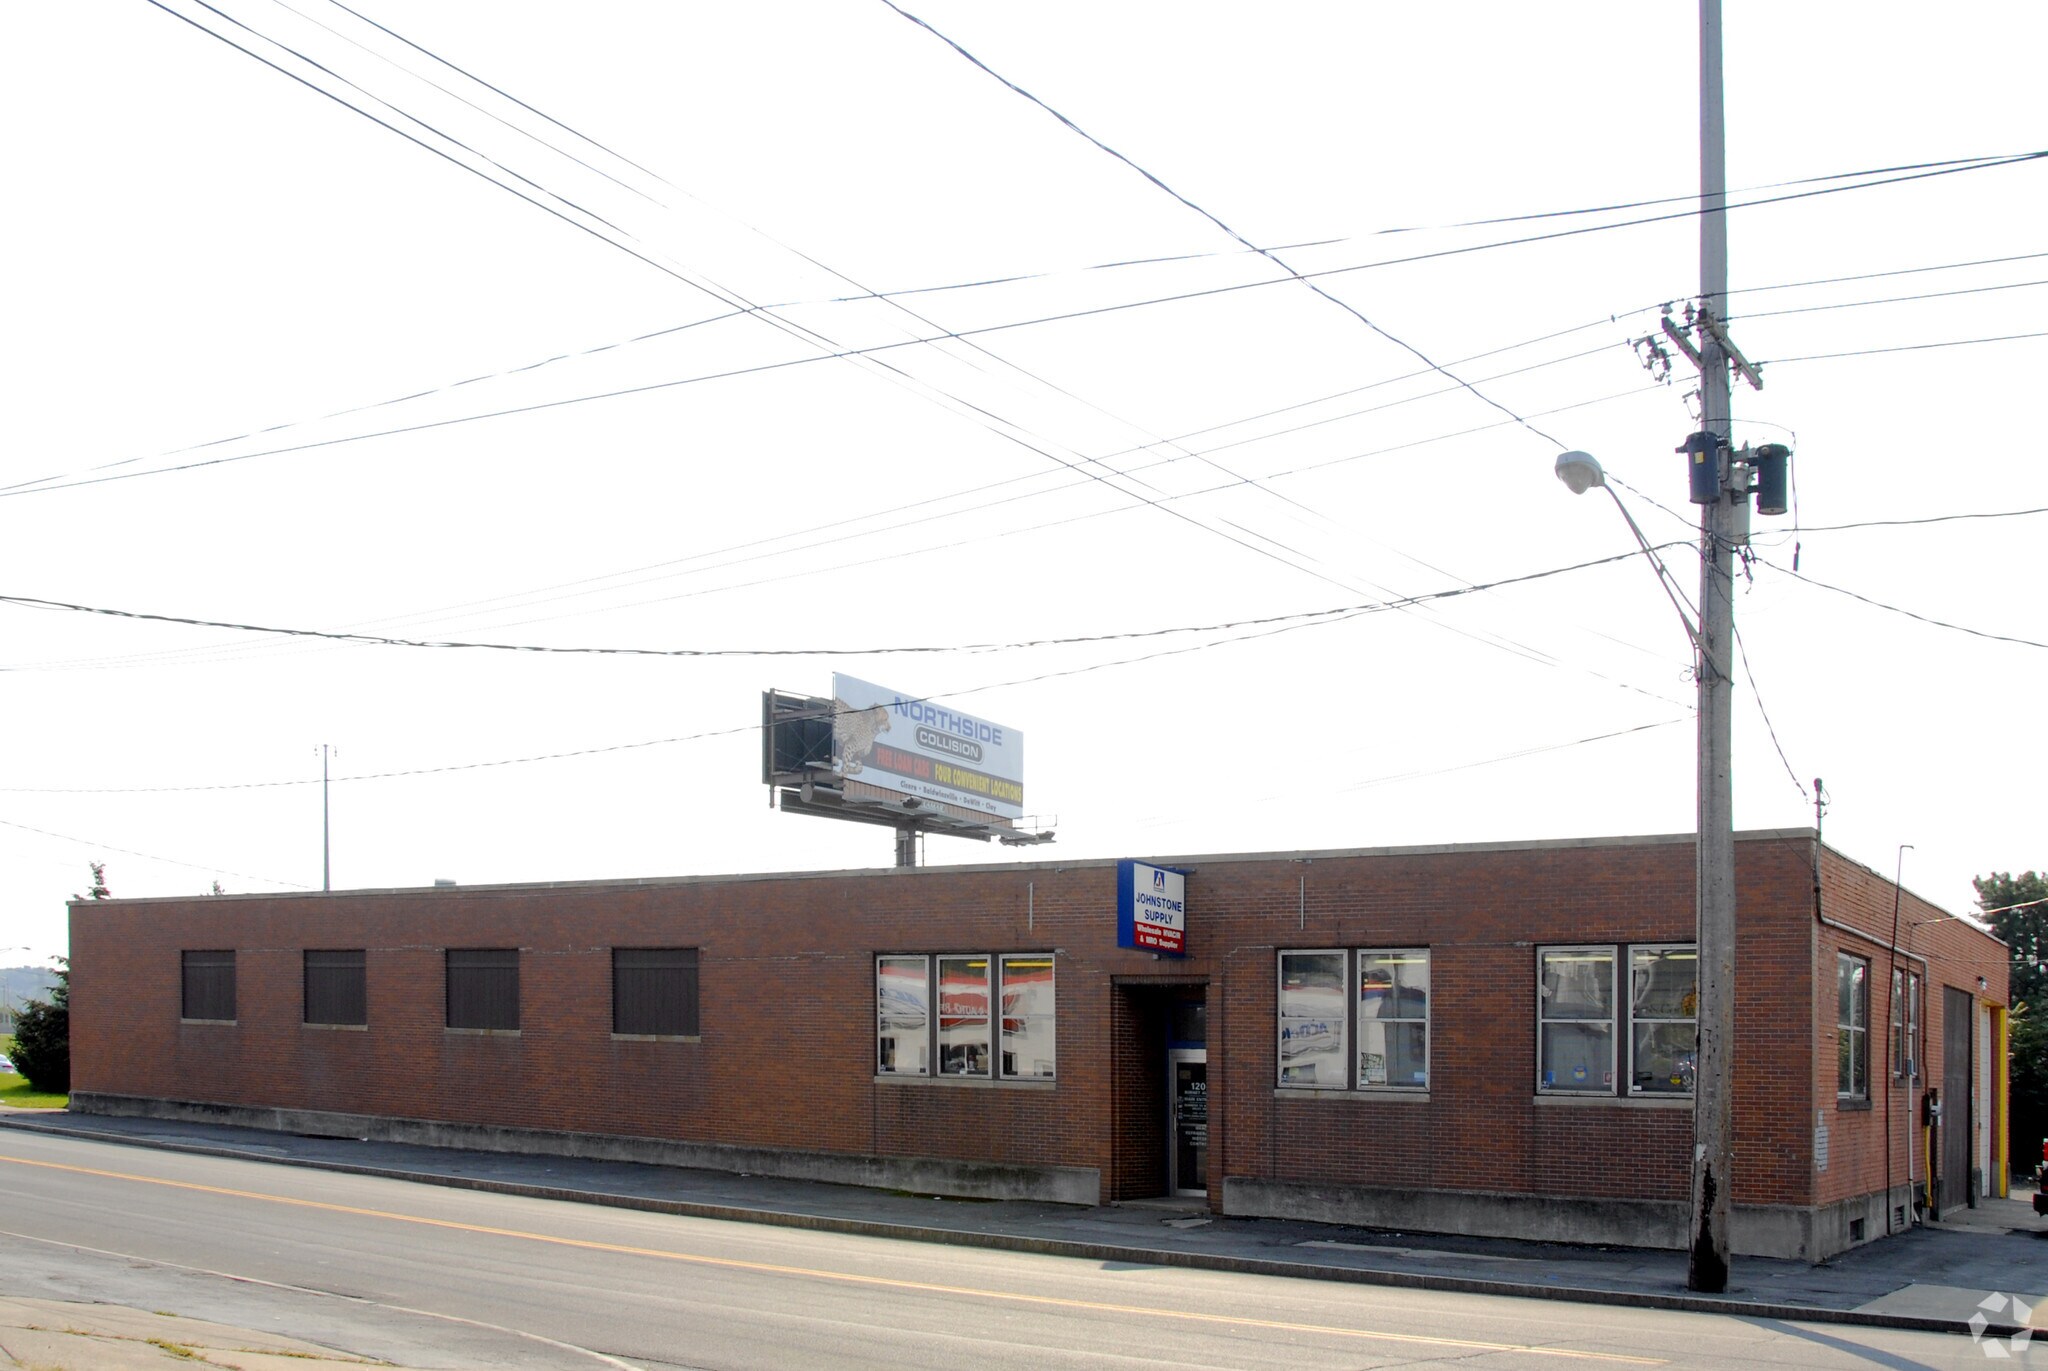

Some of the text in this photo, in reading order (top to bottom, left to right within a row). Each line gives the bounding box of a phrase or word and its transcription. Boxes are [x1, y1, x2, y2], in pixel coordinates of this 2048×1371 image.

[894, 696, 1003, 746] NORTHSIDE
[919, 731, 979, 758] COLLISION
[878, 748, 930, 778] FREE LOAN CARS
[900, 780, 997, 813] Cicero Baldwinsville DeWitt Clay
[934, 763, 1022, 803] FOUR CONVENIENT LOCATIONS
[1136, 892, 1182, 912] JOHNSTONE
[1137, 924, 1162, 936] Wholesale
[1145, 909, 1173, 924] SUPPLY
[1140, 934, 1144, 942] &
[1158, 938, 1178, 949] Supplier
